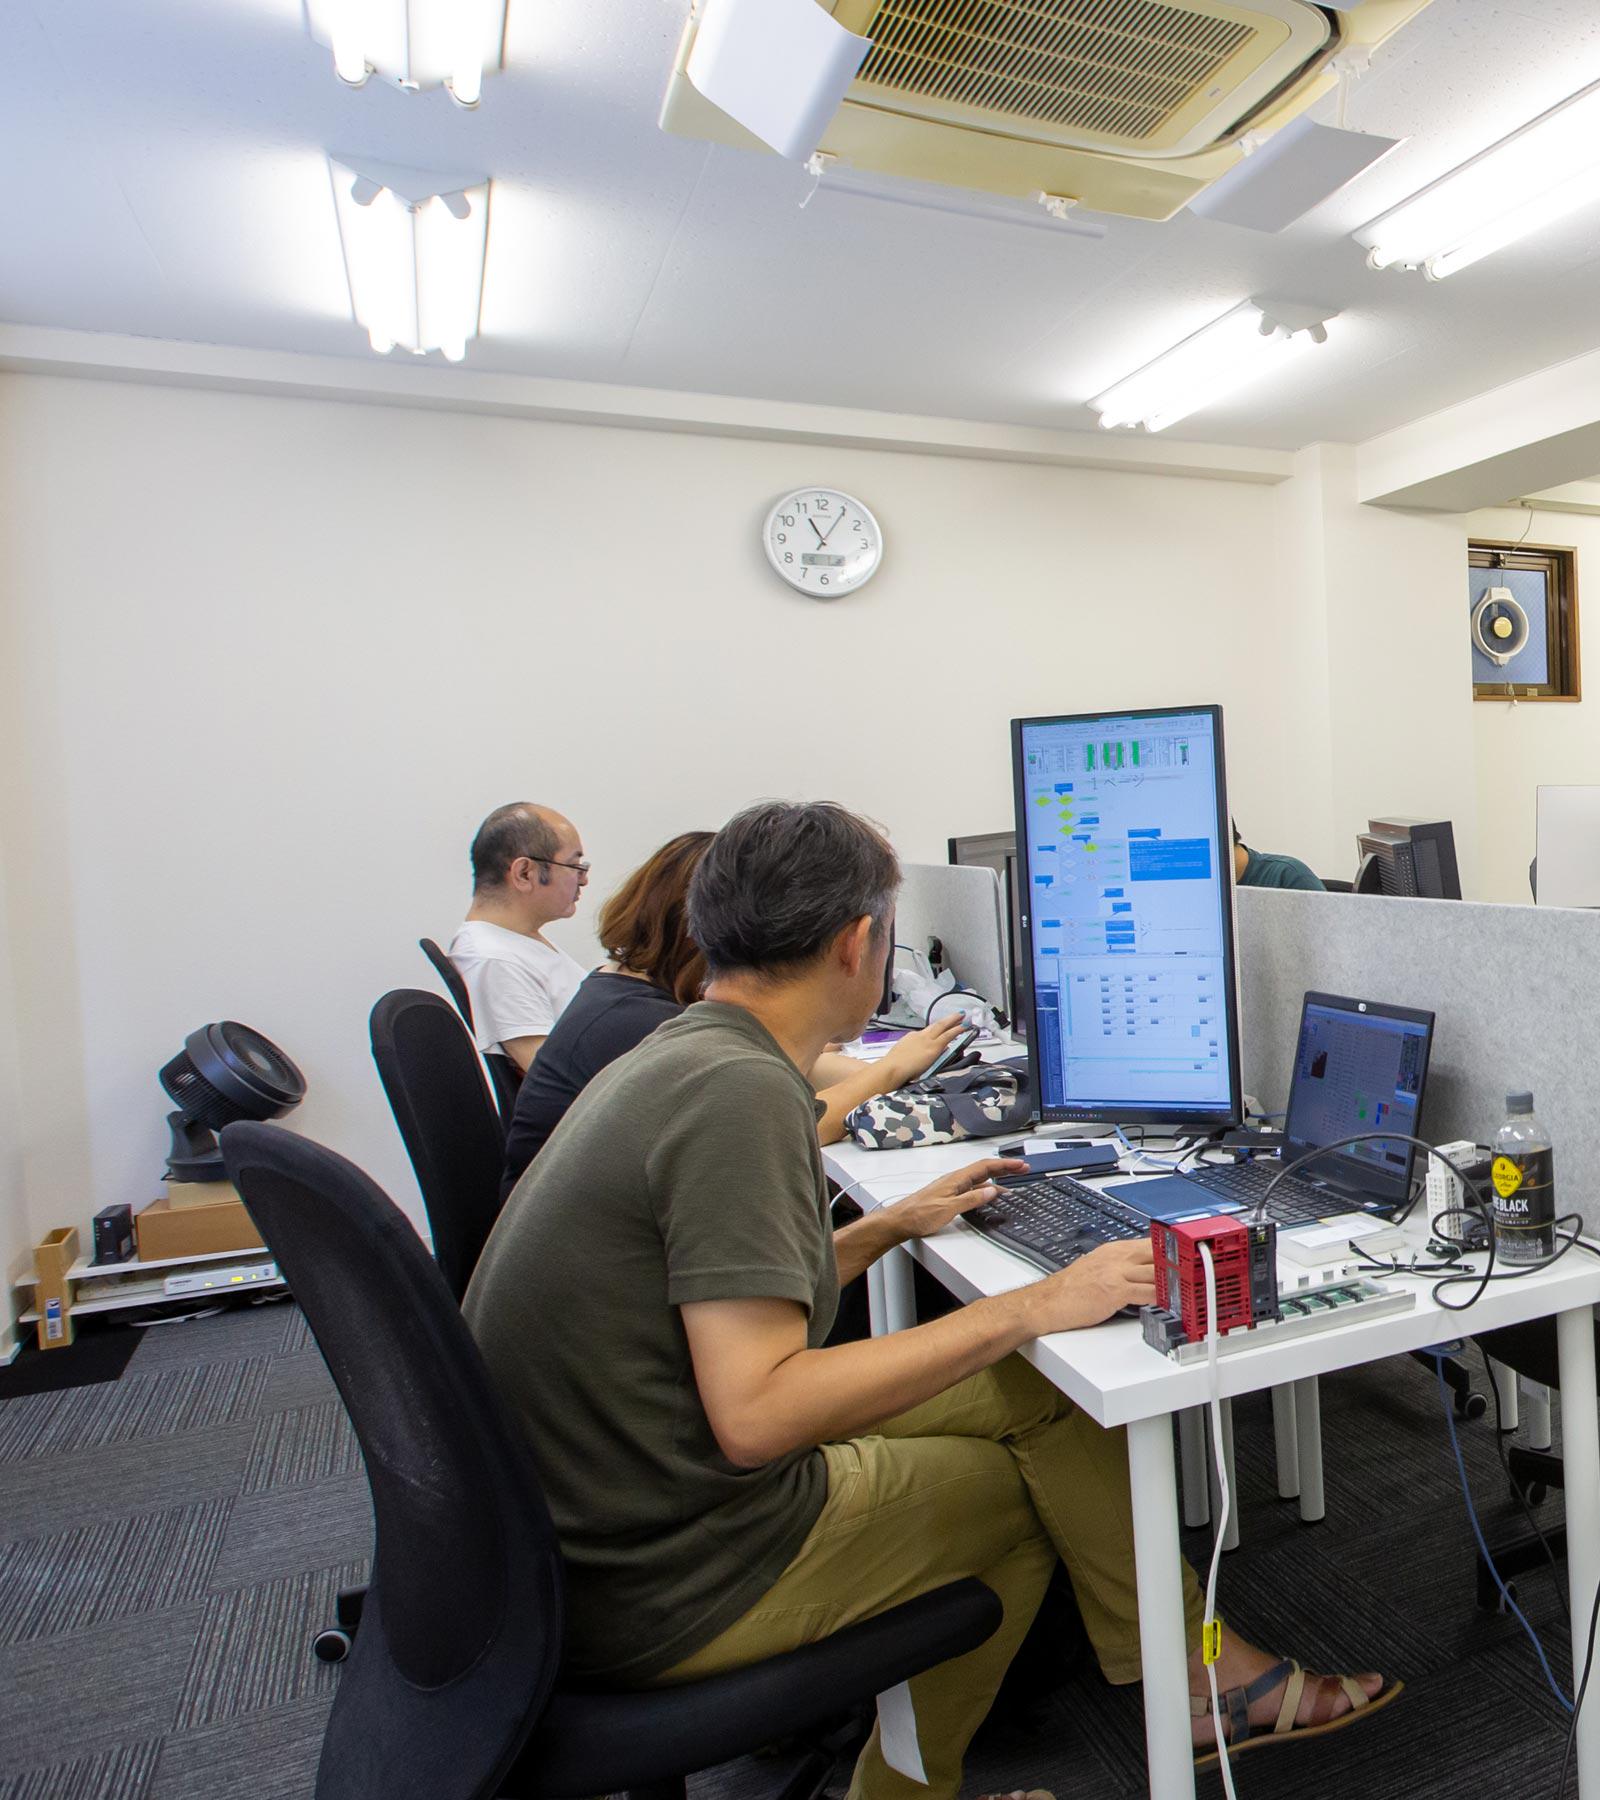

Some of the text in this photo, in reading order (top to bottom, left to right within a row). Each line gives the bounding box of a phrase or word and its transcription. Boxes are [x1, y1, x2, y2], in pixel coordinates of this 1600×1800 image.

[796, 503, 808, 514] 11
[815, 499, 829, 511] 12
[781, 515, 795, 527] 10
[853, 520, 862, 531] 2
[777, 533, 786, 544] 9
[860, 539, 869, 550] 3
[784, 552, 794, 563] 8
[800, 567, 808, 578] 7
[820, 574, 829, 585] 6
[1499, 1198, 1529, 1213] BLACK
